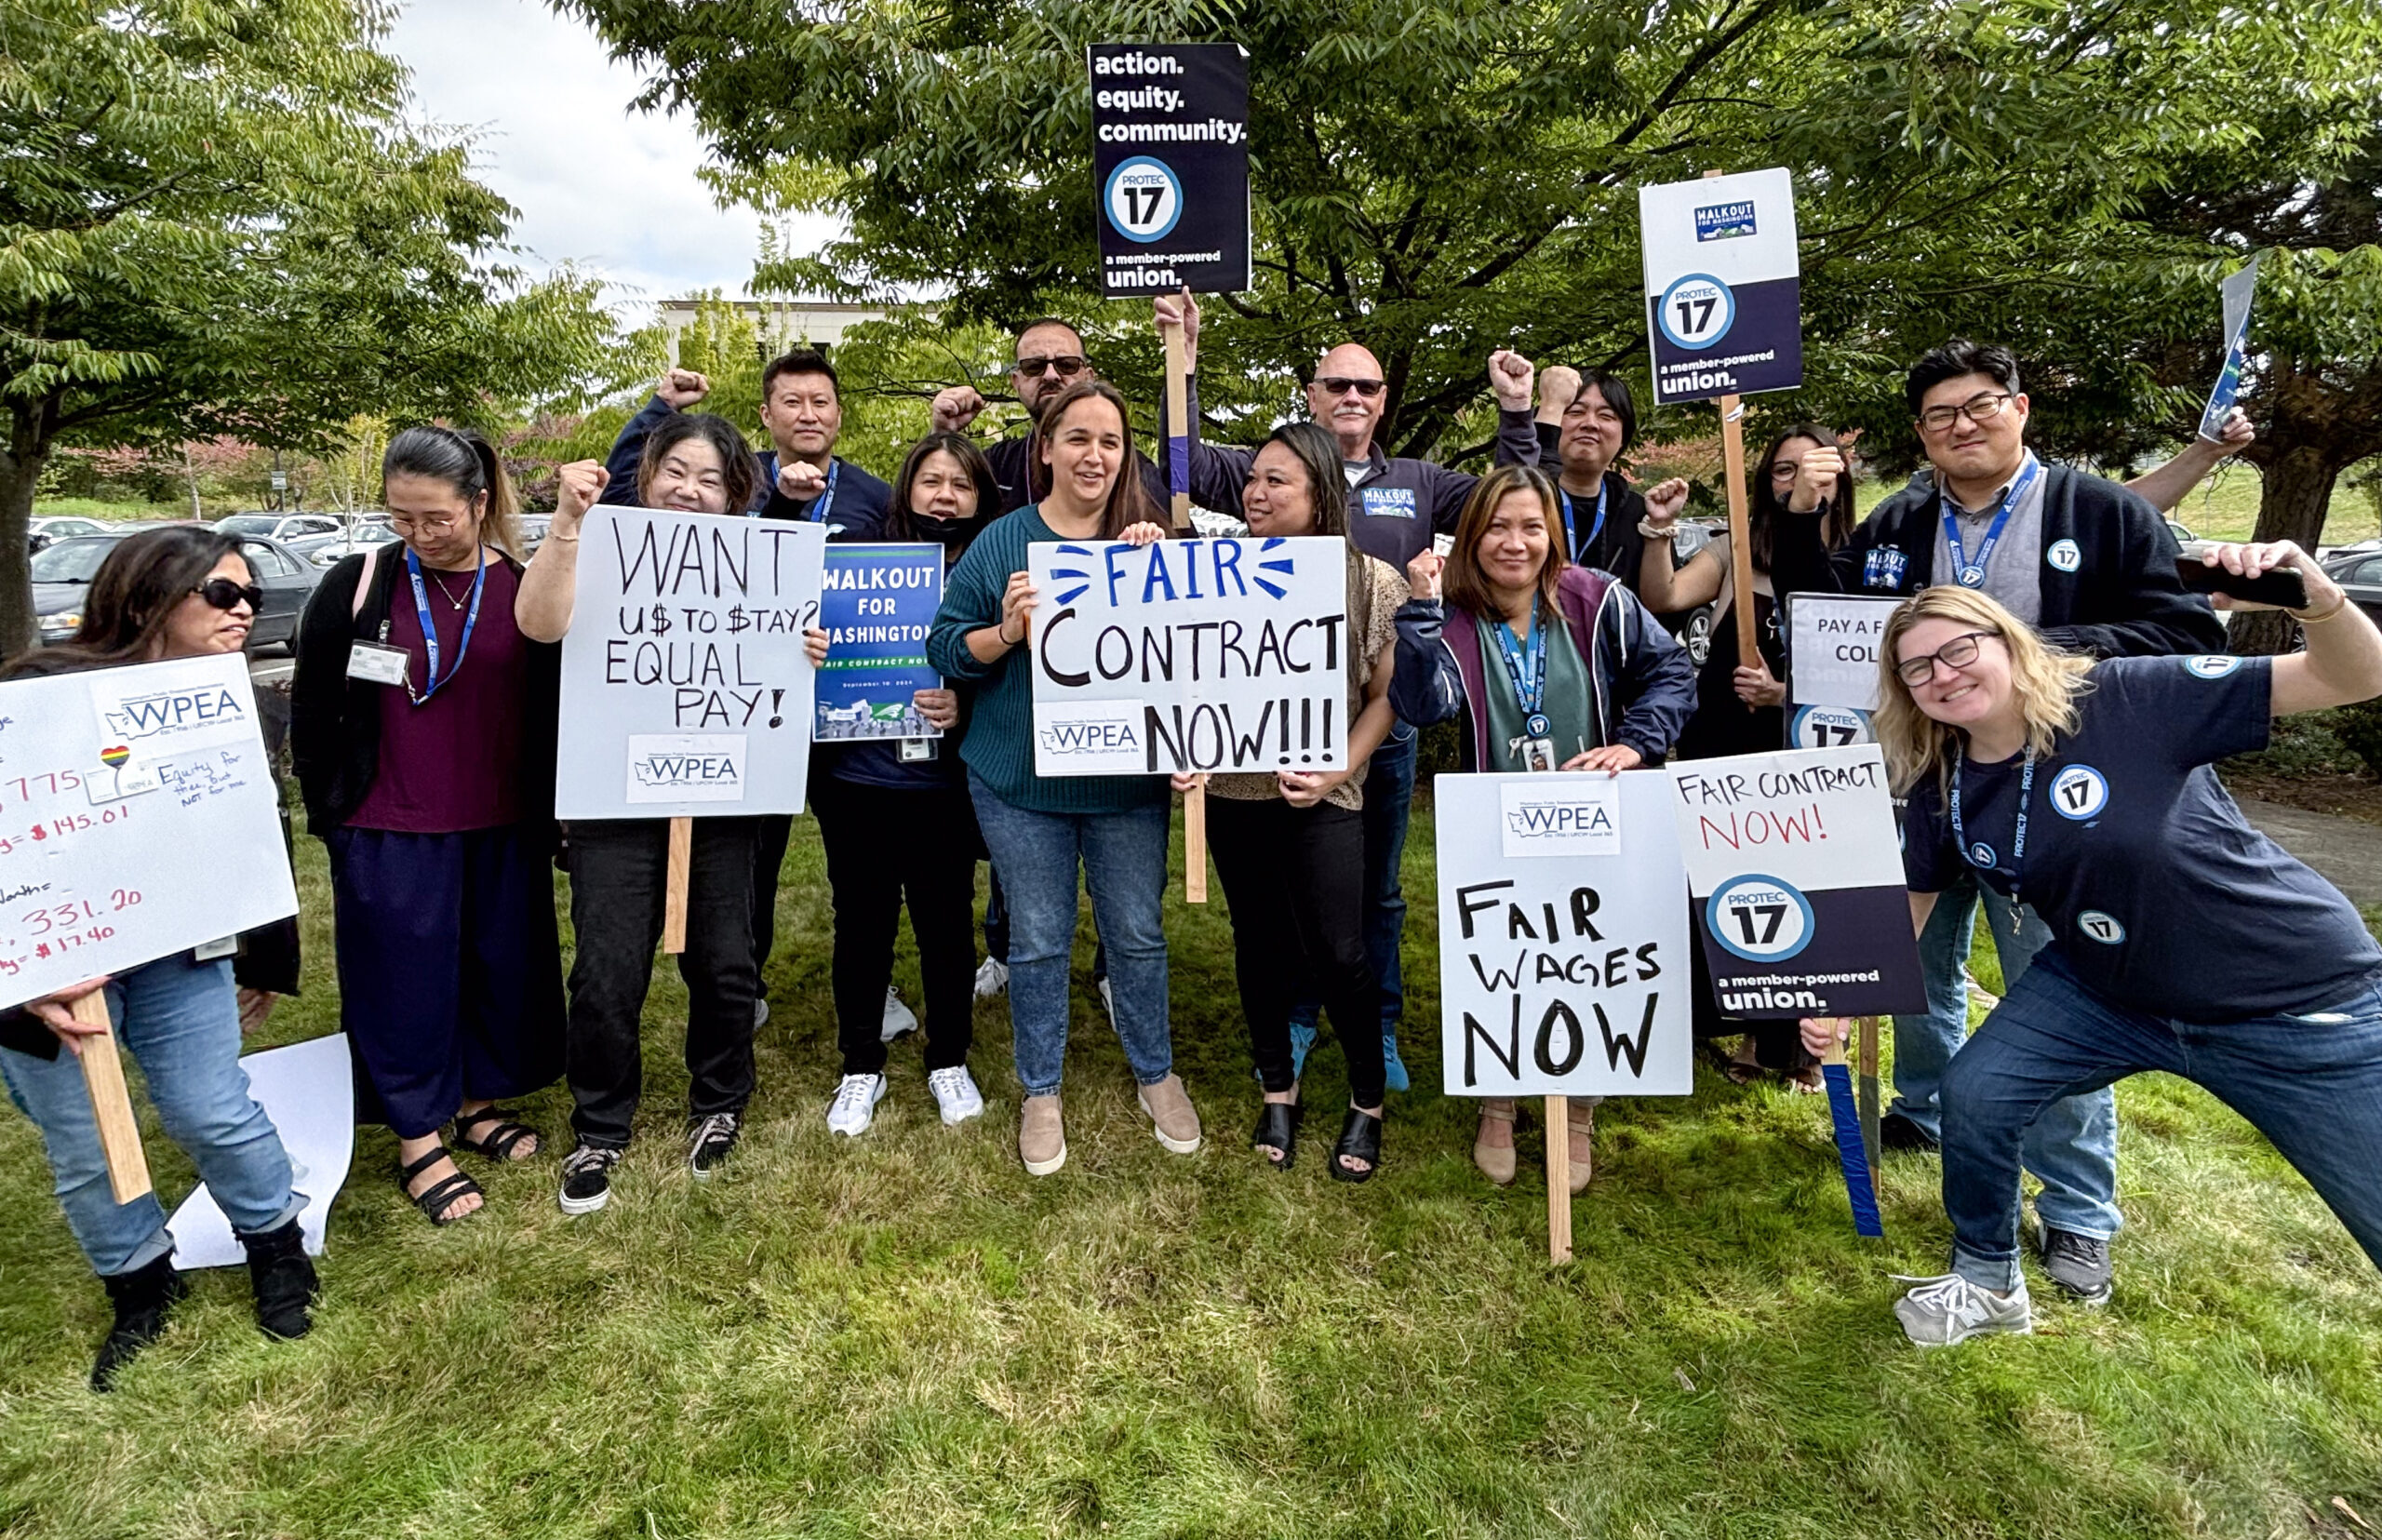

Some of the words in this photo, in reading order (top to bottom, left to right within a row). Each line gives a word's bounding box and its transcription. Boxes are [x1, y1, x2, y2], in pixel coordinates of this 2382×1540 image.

[1095, 51, 1184, 74] action.
[1096, 86, 1184, 112] equity.
[1099, 118, 1247, 143] community.
[1122, 174, 1165, 185] PROTEC
[1123, 186, 1166, 225] 17
[1697, 204, 1752, 221] WALKOUT
[1105, 254, 1114, 265] a
[1116, 249, 1221, 268] member-powered
[1106, 265, 1183, 288] union.
[1675, 287, 1718, 301] PROTEC
[1676, 297, 1719, 336] 17
[1660, 364, 1668, 375] a
[1670, 349, 1775, 373] member-powered
[1662, 370, 1737, 395] union.
[611, 517, 798, 598] WANT
[2057, 550, 2076, 565] 17
[823, 567, 935, 591] WALKOUT
[1104, 540, 1247, 607] FAIR
[1963, 571, 1981, 584] 17
[682, 608, 717, 634] TO
[727, 600, 819, 636] $TAY?
[858, 597, 896, 615] FOR
[1817, 619, 1852, 634] PAY
[1855, 620, 1868, 634] A
[1040, 608, 1345, 687] CONTRACT
[1836, 645, 1879, 663] COL
[606, 640, 763, 687] EQUAL
[848, 658, 903, 667] CONTRACT
[127, 690, 242, 730] WPEA
[676, 689, 783, 729] PAY!
[1812, 713, 1858, 726] PROTEC
[1054, 725, 1138, 747] WPEA
[1144, 697, 1333, 771] NOW!!!
[1532, 721, 1545, 734] 17
[1812, 723, 1858, 747] 17
[158, 761, 214, 784] Equity
[650, 758, 738, 780] WPEA
[1677, 771, 1752, 807] FAIR
[1759, 761, 1880, 800] CONTRACT
[2062, 779, 2090, 810] 17
[181, 793, 202, 807] NOT
[1523, 807, 1612, 831] WPEA
[1699, 803, 1827, 850] NOW!
[1728, 890, 1786, 905] PROTEC
[1456, 879, 1605, 944] FAIR
[1731, 904, 1788, 944] 17
[2087, 921, 2111, 938] 17
[1468, 942, 1661, 993] WAGES
[1718, 976, 1729, 988] a
[1733, 969, 1880, 990] member-powered
[1722, 986, 1827, 1011] union.
[1463, 992, 1659, 1088] NOW
